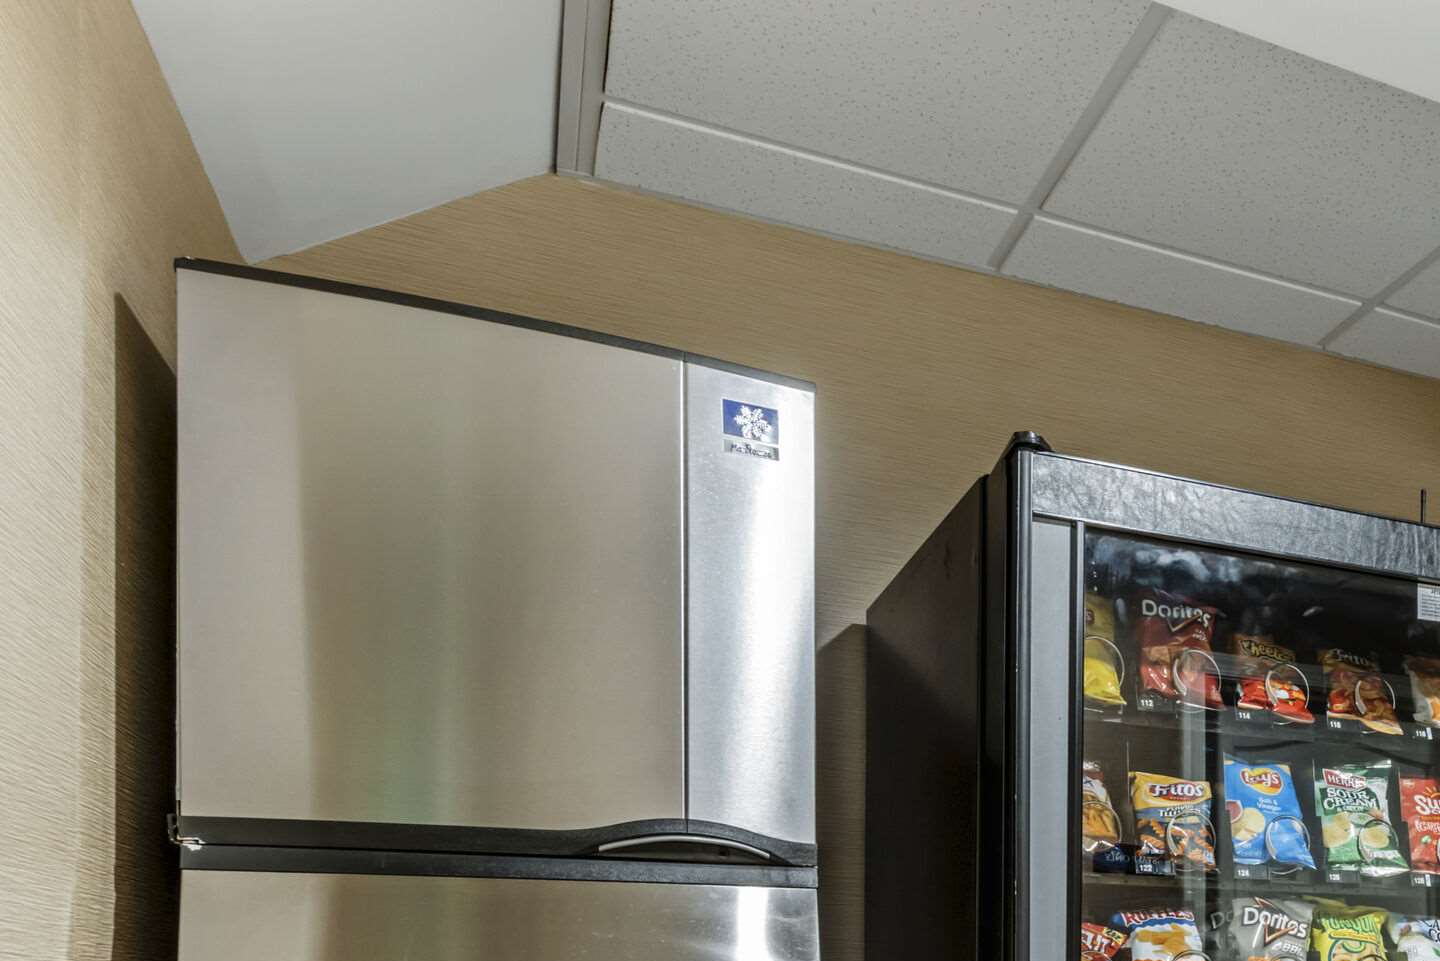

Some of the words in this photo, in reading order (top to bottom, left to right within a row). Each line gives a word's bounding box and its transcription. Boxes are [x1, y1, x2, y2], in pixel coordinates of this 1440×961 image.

[1142, 600, 1211, 628] Doritos
[1244, 770, 1280, 787] Lay's
[1327, 787, 1369, 799] SOUR
[1323, 798, 1377, 811] CREAM
[1243, 907, 1308, 938] Doritos
